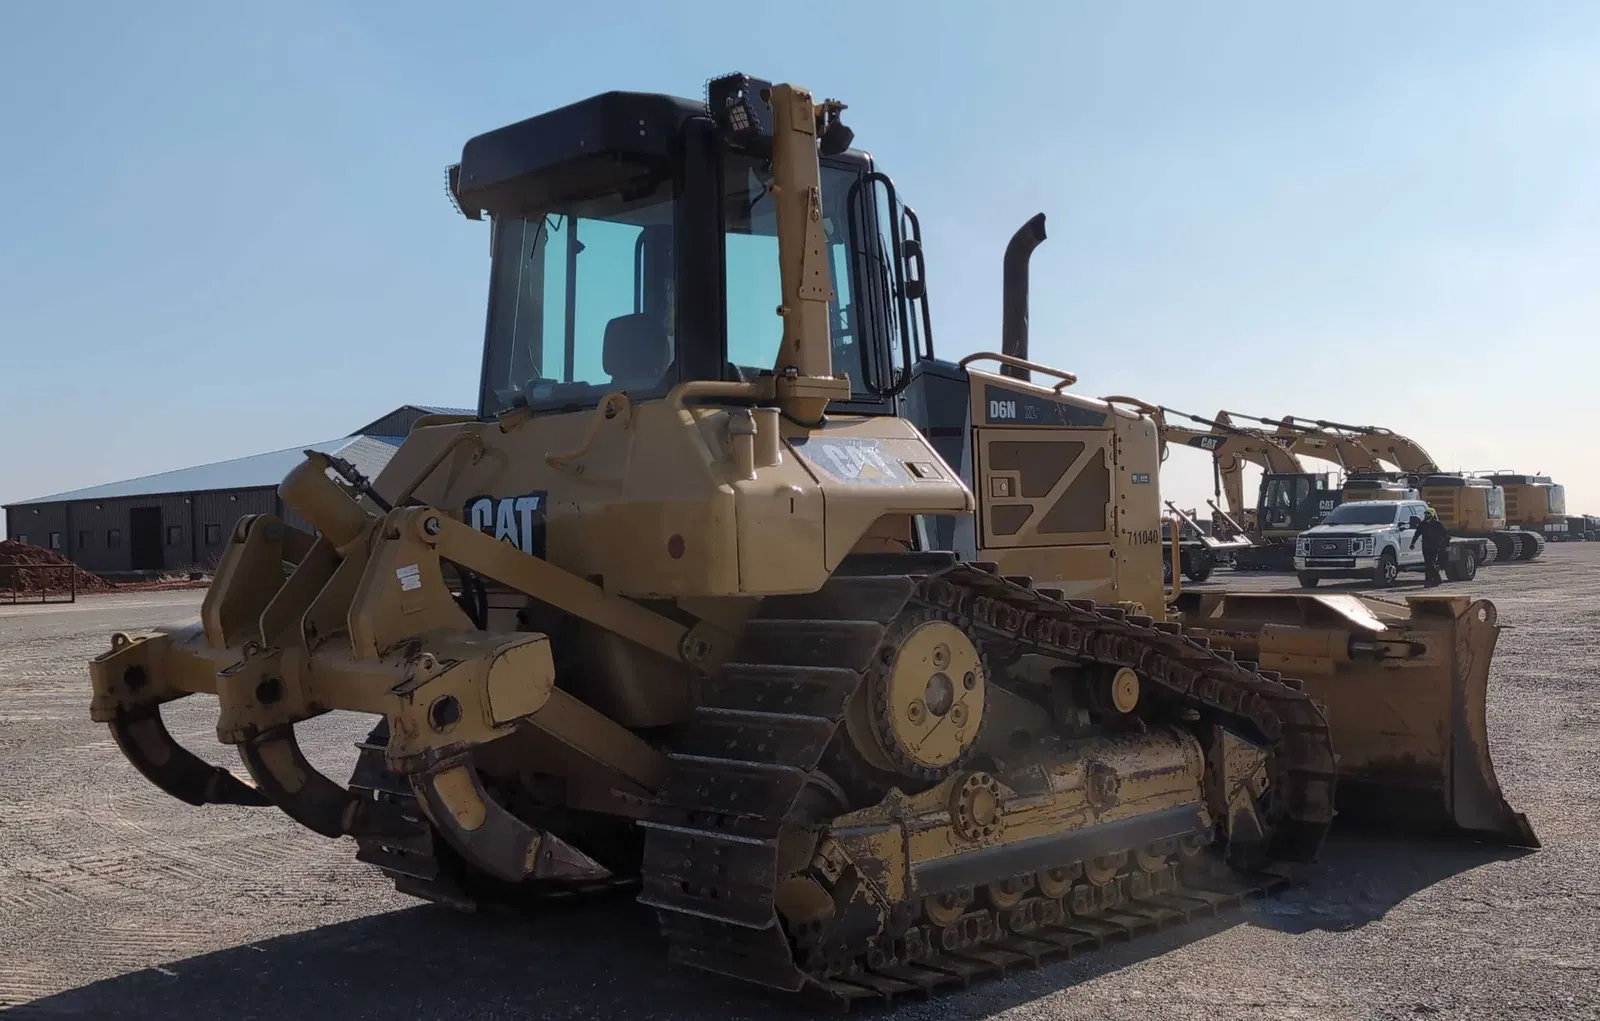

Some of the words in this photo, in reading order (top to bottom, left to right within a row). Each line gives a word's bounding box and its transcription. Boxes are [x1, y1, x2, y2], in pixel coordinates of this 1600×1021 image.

[990, 400, 1016, 419] D6N
[1200, 436, 1218, 450] CAT
[822, 442, 898, 479] CAT
[1319, 499, 1335, 510] CAT
[471, 496, 540, 556] CAT
[1127, 530, 1159, 546] 711040
